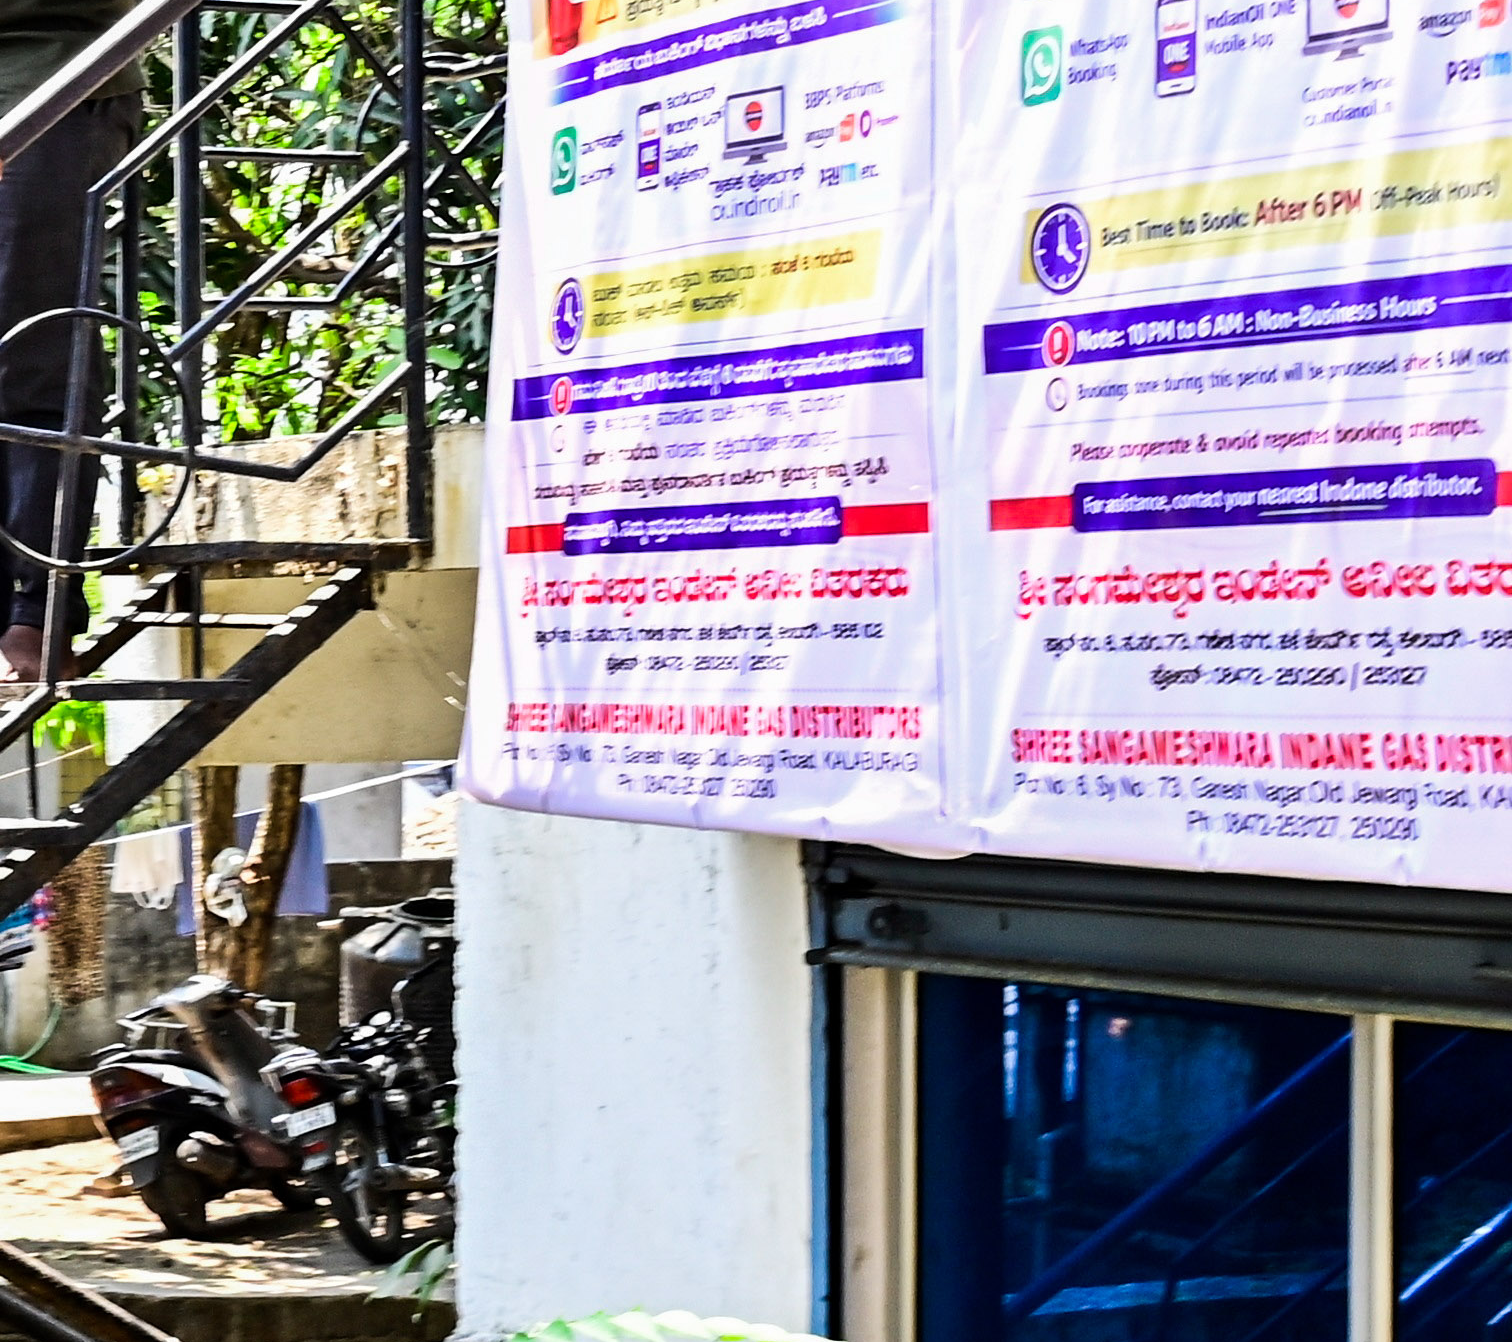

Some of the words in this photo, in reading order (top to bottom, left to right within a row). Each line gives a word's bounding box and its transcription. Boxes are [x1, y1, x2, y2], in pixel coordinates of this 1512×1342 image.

[1136, 217, 1174, 241] Time
[1179, 215, 1196, 236] to
[1253, 196, 1307, 228] After
[1312, 191, 1326, 219] 6
[1331, 187, 1363, 217] PM
[1077, 327, 1126, 353] Note:
[1380, 294, 1437, 320] Hours
[1335, 420, 1403, 446] booking
[1011, 727, 1073, 764] SHREE
[1382, 732, 1427, 770] GAS
